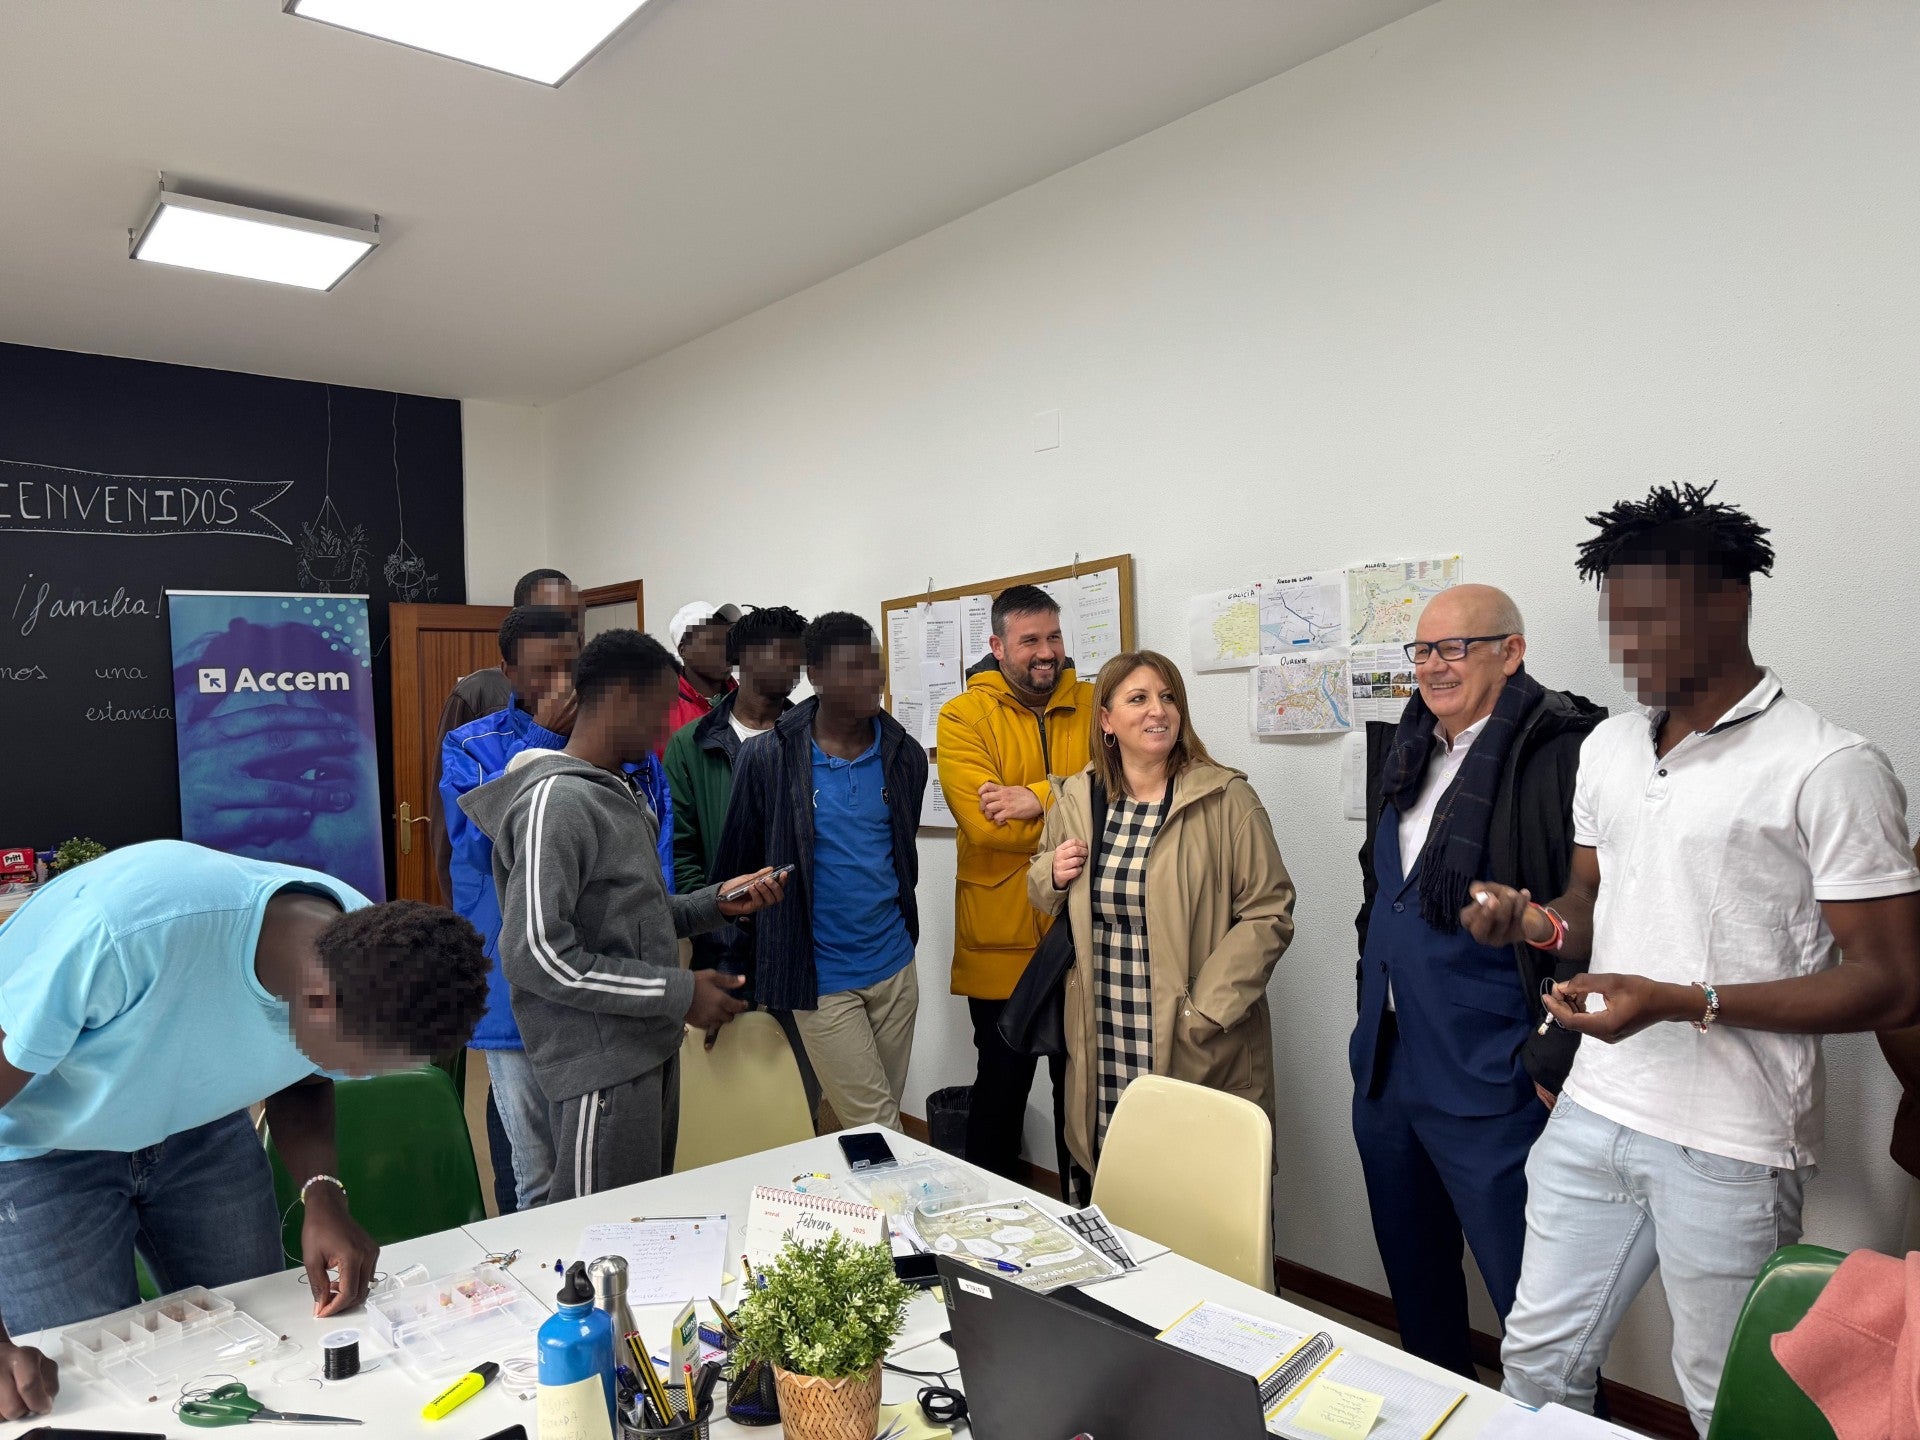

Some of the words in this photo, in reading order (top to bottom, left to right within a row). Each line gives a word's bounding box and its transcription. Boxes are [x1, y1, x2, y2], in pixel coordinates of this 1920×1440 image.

[1227, 590, 1255, 600] GALICIA
[1280, 656, 1307, 666] OURENSE
[95, 667, 148, 679] una
[234, 667, 350, 693] Accem
[85, 700, 174, 721] estancia
[5, 854, 21, 864] Pritt
[796, 1211, 833, 1231] Febrero
[852, 1226, 866, 1235] 2025
